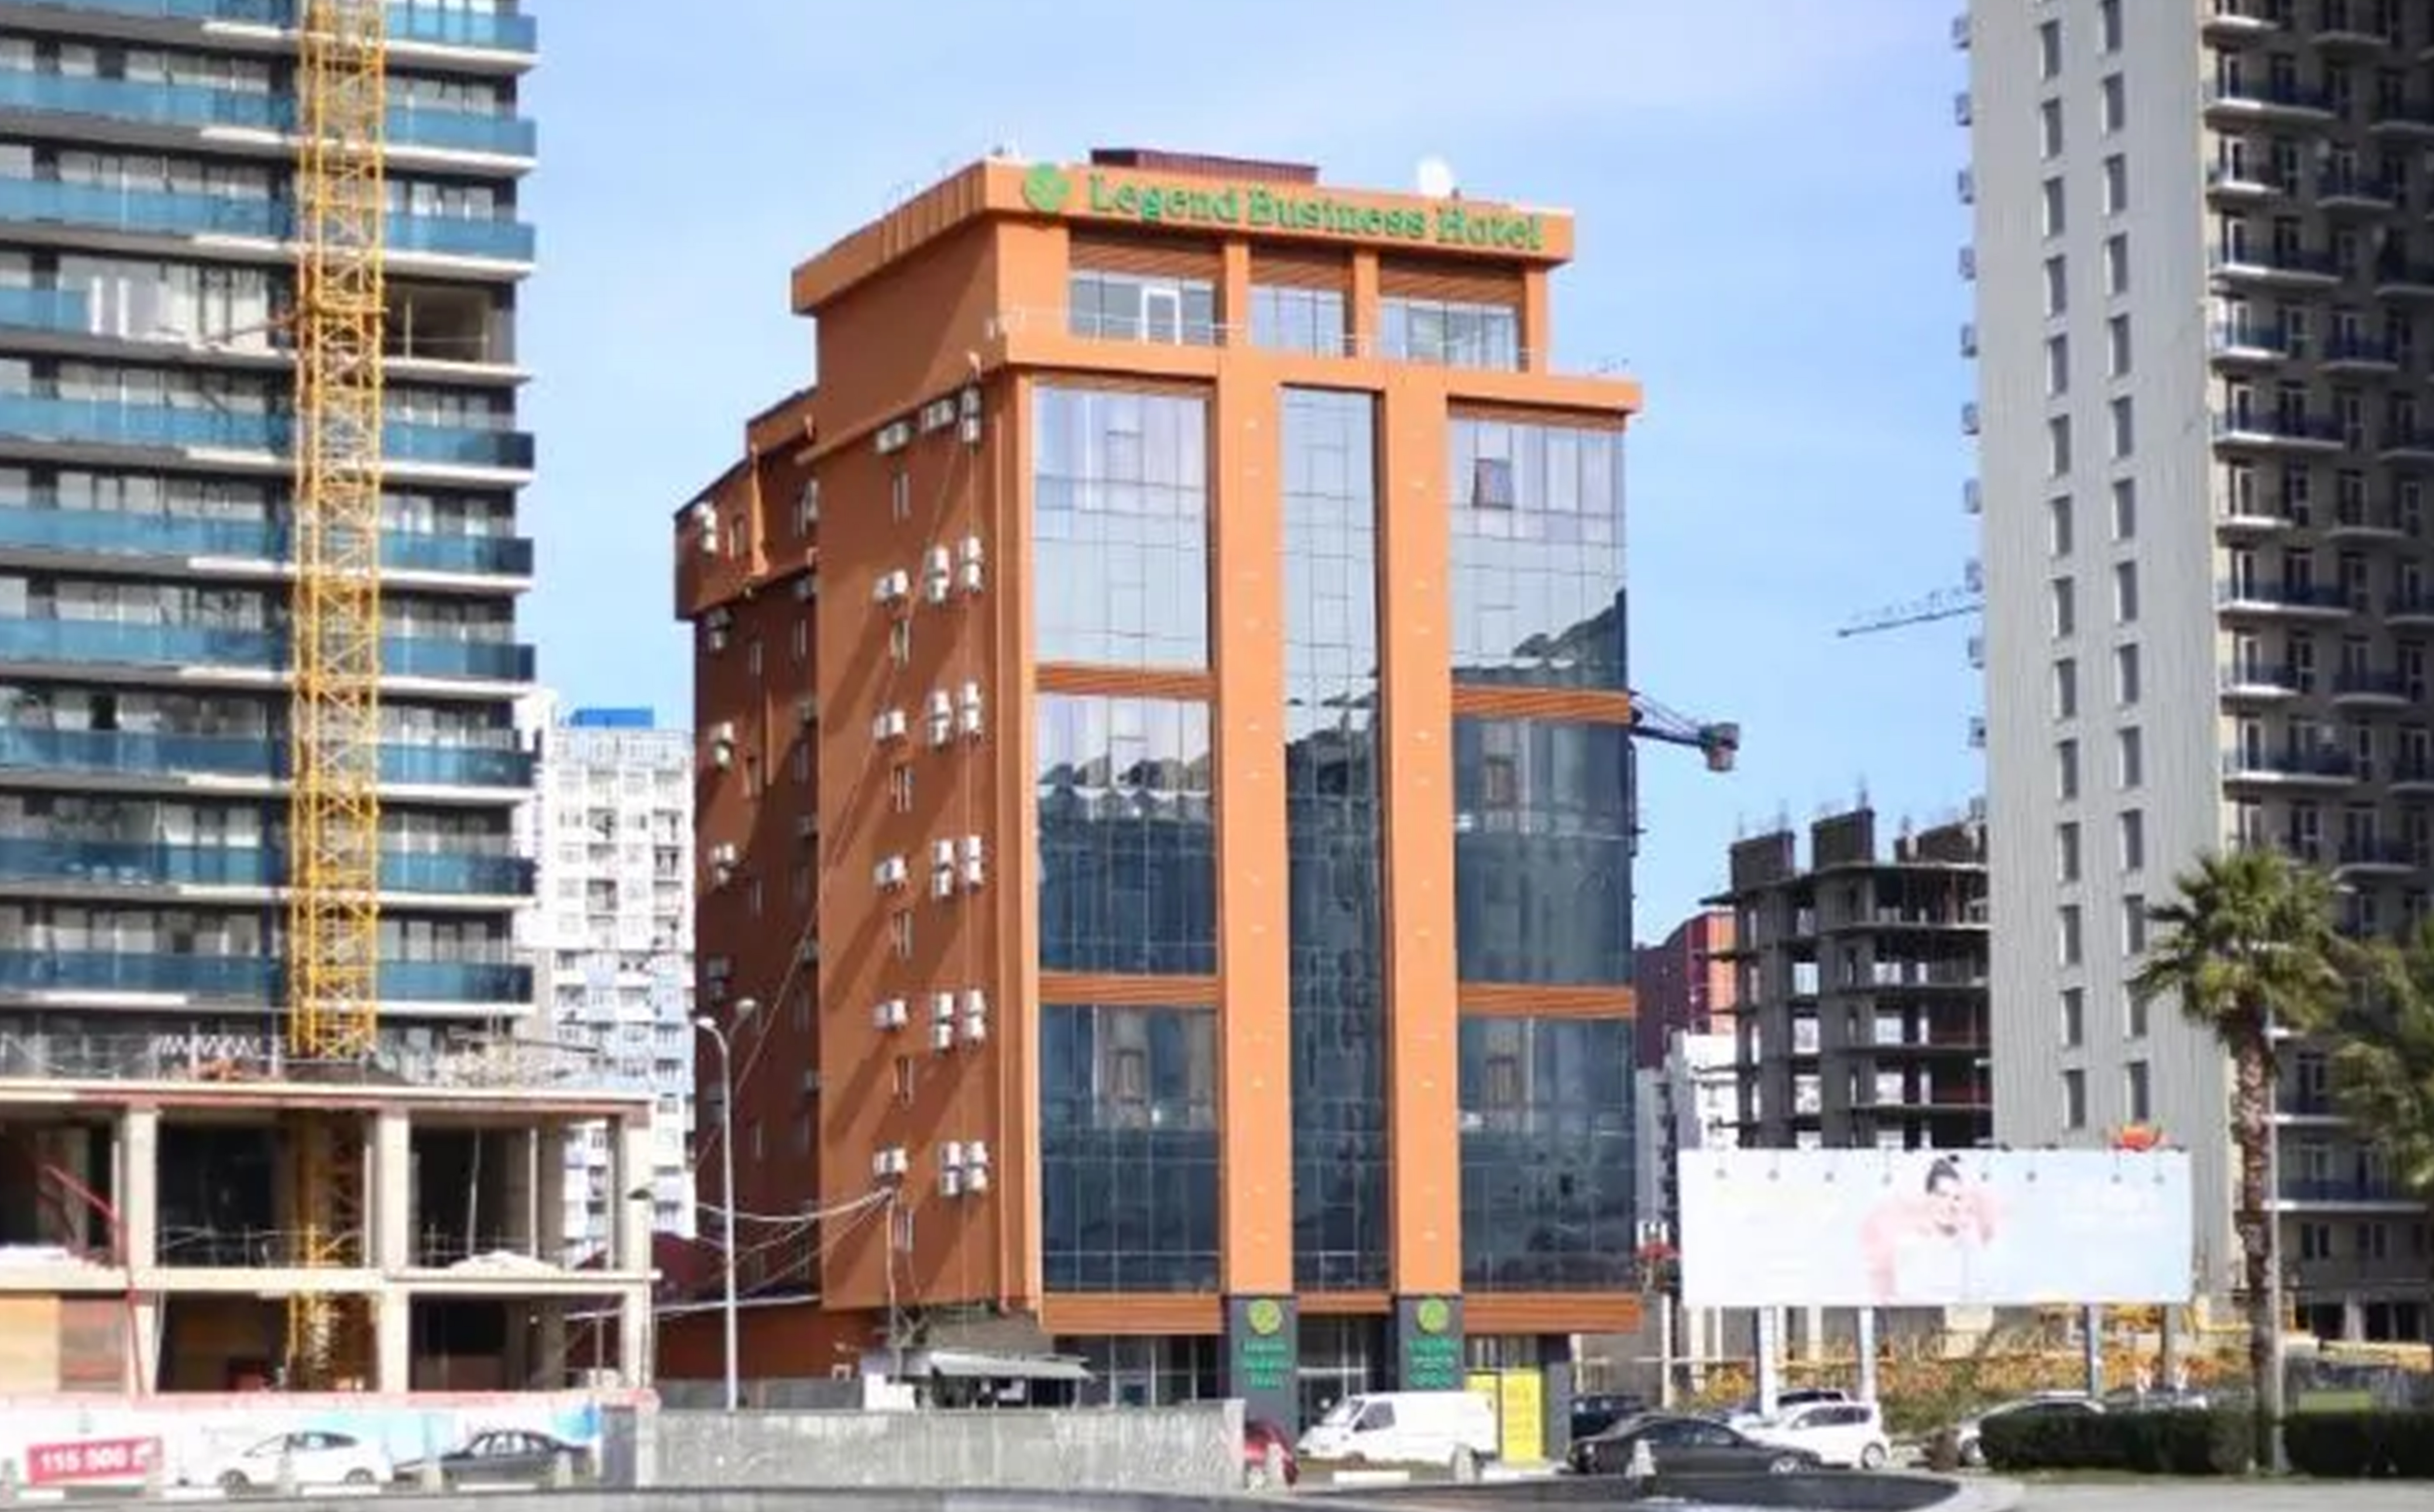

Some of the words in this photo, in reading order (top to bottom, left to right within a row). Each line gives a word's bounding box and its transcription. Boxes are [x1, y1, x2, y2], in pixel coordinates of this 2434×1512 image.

[1089, 172, 1239, 224] Legend
[1248, 184, 1426, 239] Business
[1436, 207, 1545, 251] Hotel
